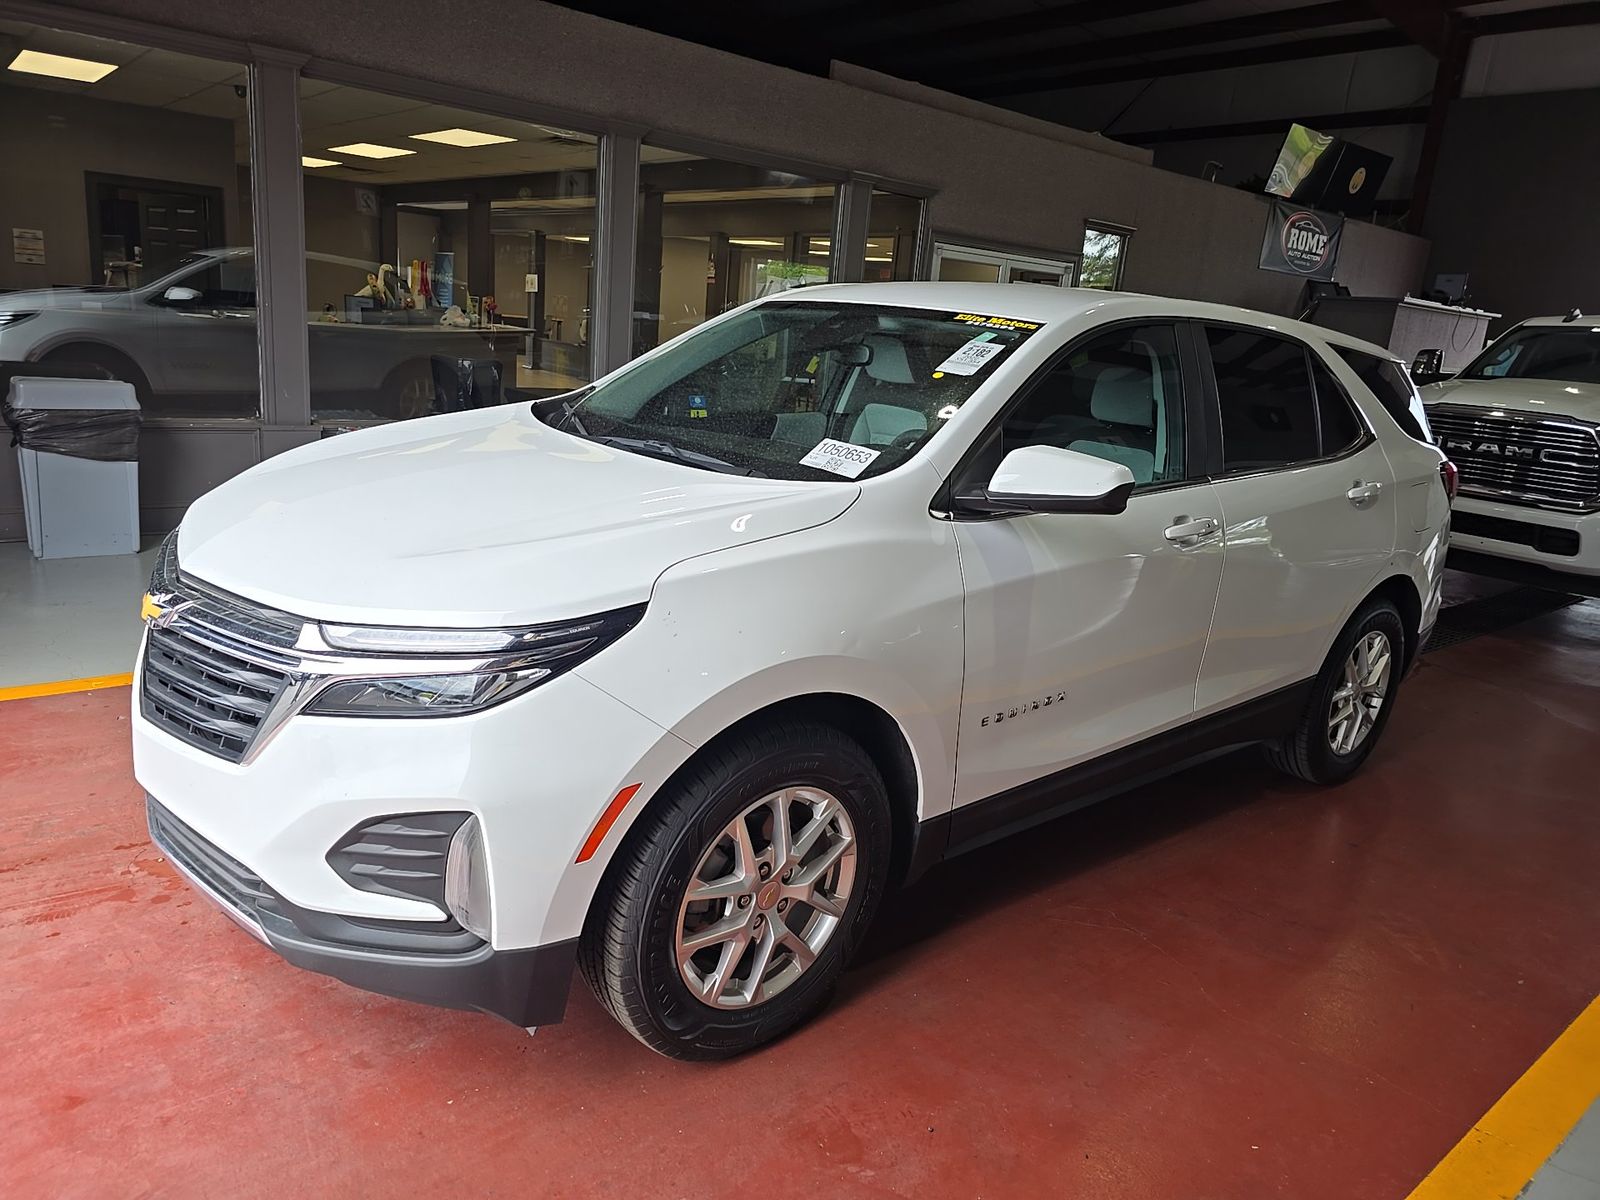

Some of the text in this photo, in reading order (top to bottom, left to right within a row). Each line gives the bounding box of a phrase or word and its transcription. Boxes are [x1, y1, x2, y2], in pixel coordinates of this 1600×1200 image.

[1288, 228, 1328, 254] ROME
[1302, 253, 1321, 261] AUCTION
[953, 314, 986, 323] Elite
[986, 317, 1039, 330] Motors
[817, 441, 873, 464] 1050653
[1446, 441, 1534, 459] RAM
[980, 691, 1066, 728] EQUINOX
